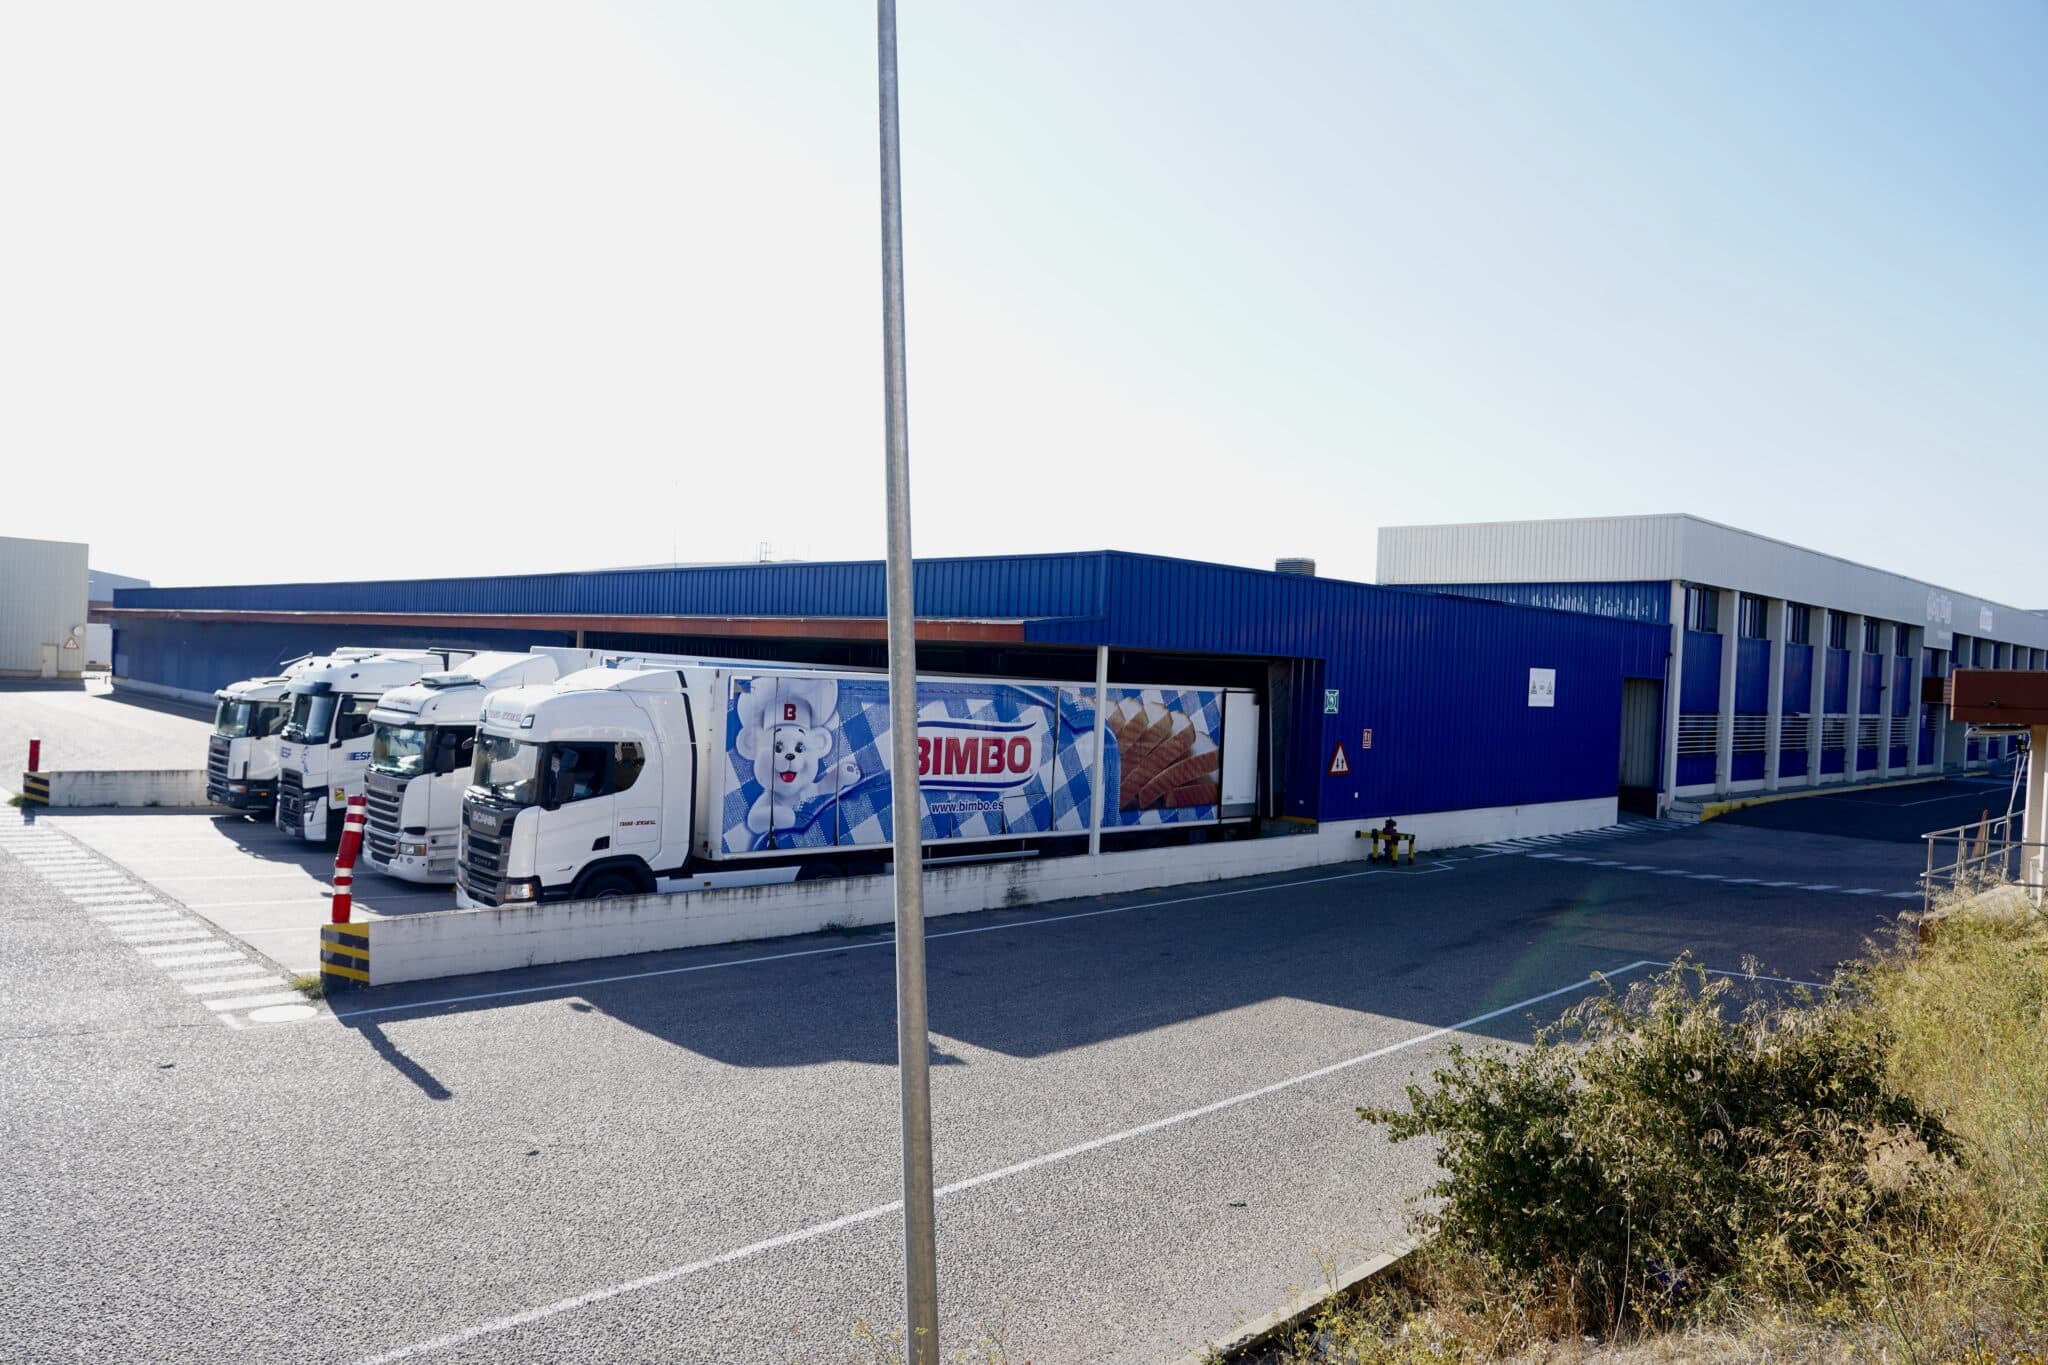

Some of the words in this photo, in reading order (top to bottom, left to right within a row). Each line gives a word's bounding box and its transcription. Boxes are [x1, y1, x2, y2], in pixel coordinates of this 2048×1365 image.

[784, 704, 796, 720] B
[931, 801, 1004, 815] www.bimbo.es
[472, 810, 497, 827] SCANIA
